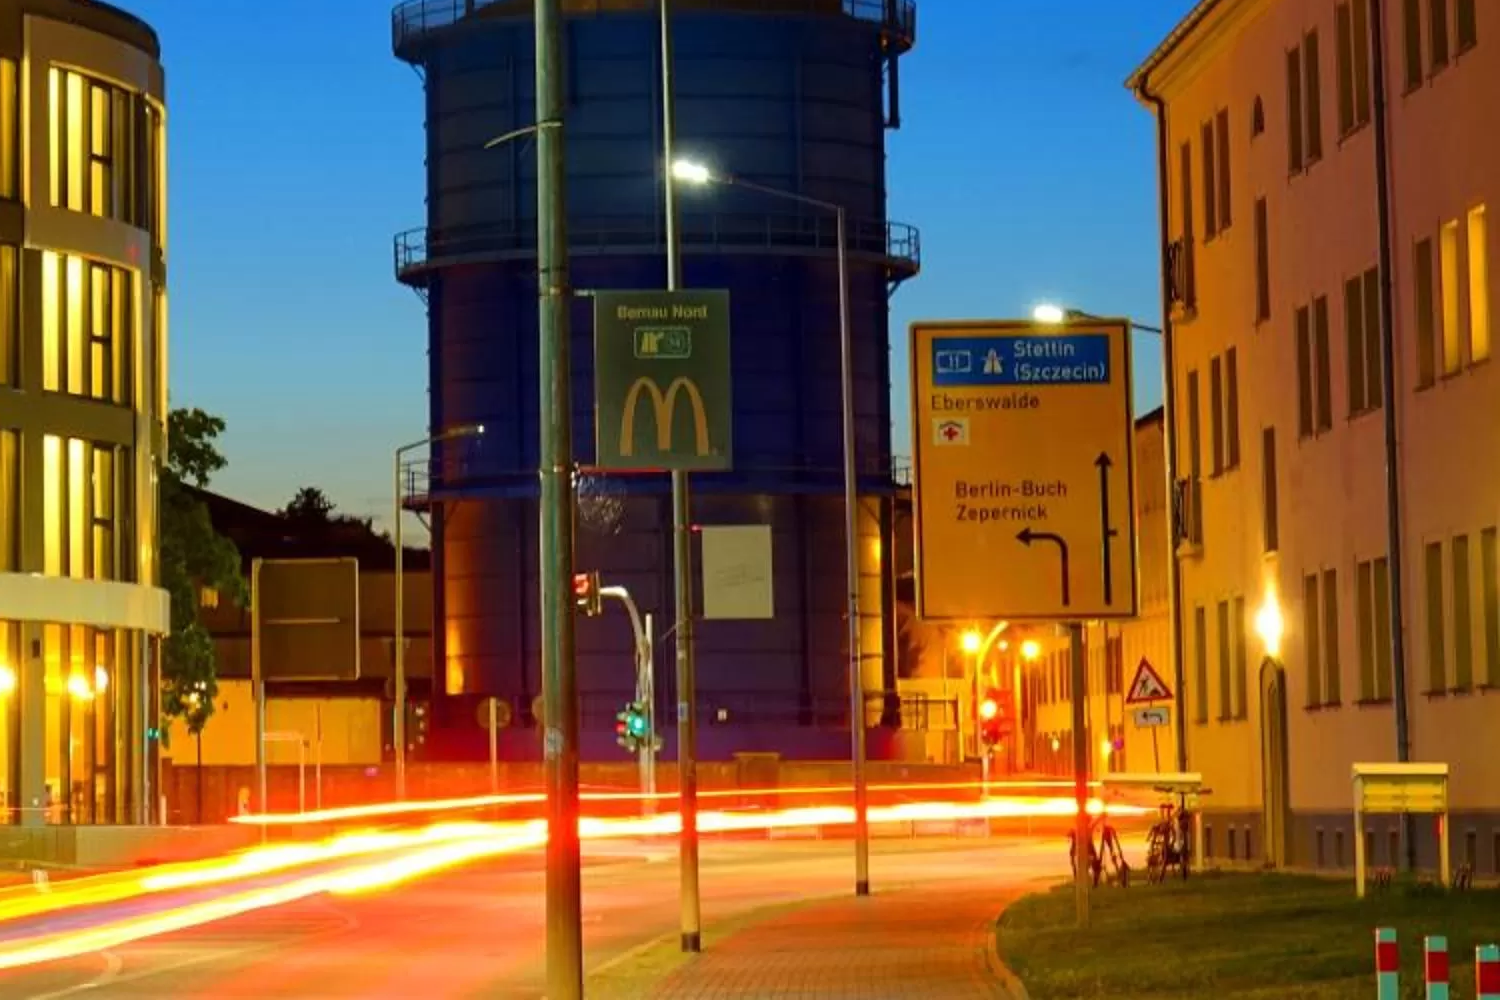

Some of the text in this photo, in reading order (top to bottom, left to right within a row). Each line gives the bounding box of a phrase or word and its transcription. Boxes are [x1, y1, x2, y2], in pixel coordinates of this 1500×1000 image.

[617, 304, 708, 319] Bernau Nord
[1013, 339, 1075, 357] Stettin
[1013, 361, 1106, 382] (Szczecin)
[931, 391, 1040, 411] Eberswalde
[955, 479, 1068, 499] Berlin-Buch
[956, 503, 1048, 524] Zepernick
